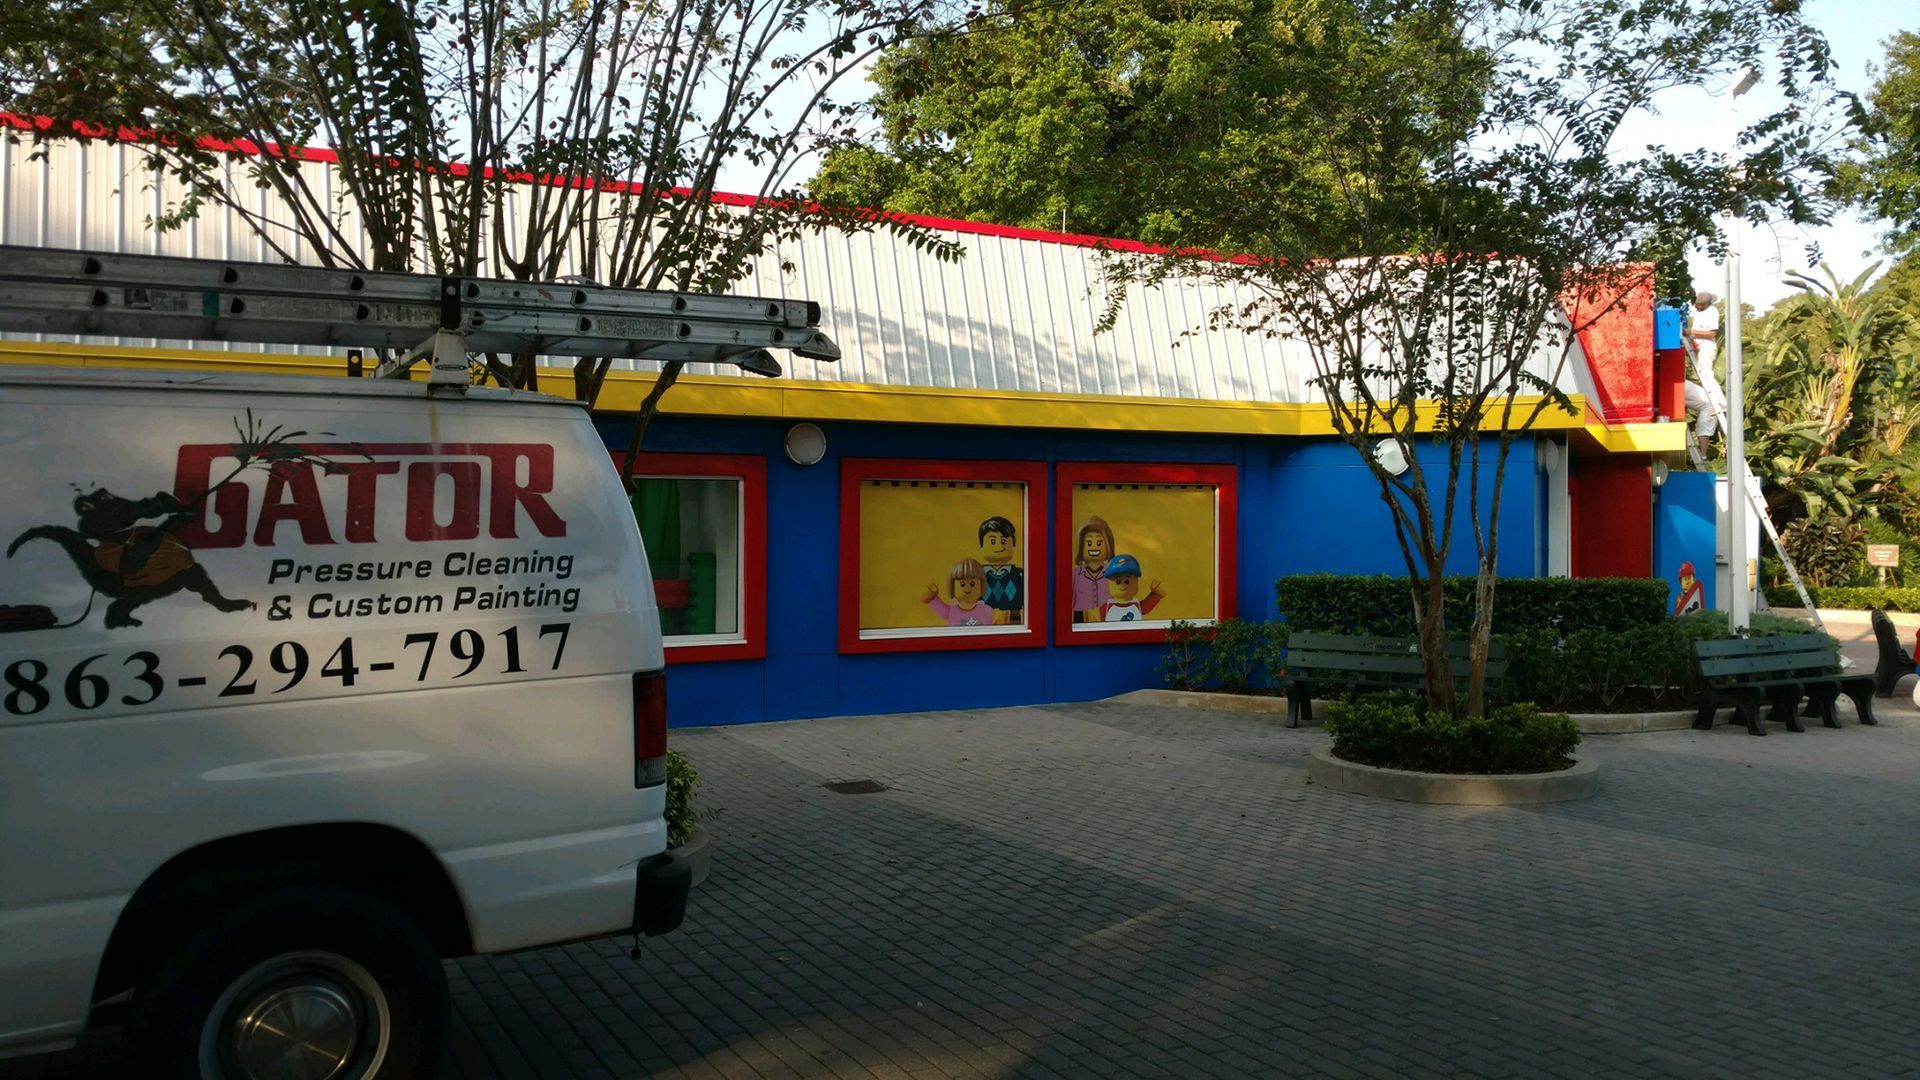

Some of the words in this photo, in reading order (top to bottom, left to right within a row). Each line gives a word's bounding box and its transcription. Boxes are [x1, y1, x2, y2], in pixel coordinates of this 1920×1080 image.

[173, 442, 567, 549] GATOR
[267, 558, 432, 584] Pressure
[443, 550, 575, 578] Cleaning
[267, 596, 292, 620] &
[307, 592, 443, 619] Custom
[453, 584, 581, 612] Painting
[2, 623, 572, 716] 863-294-7917
